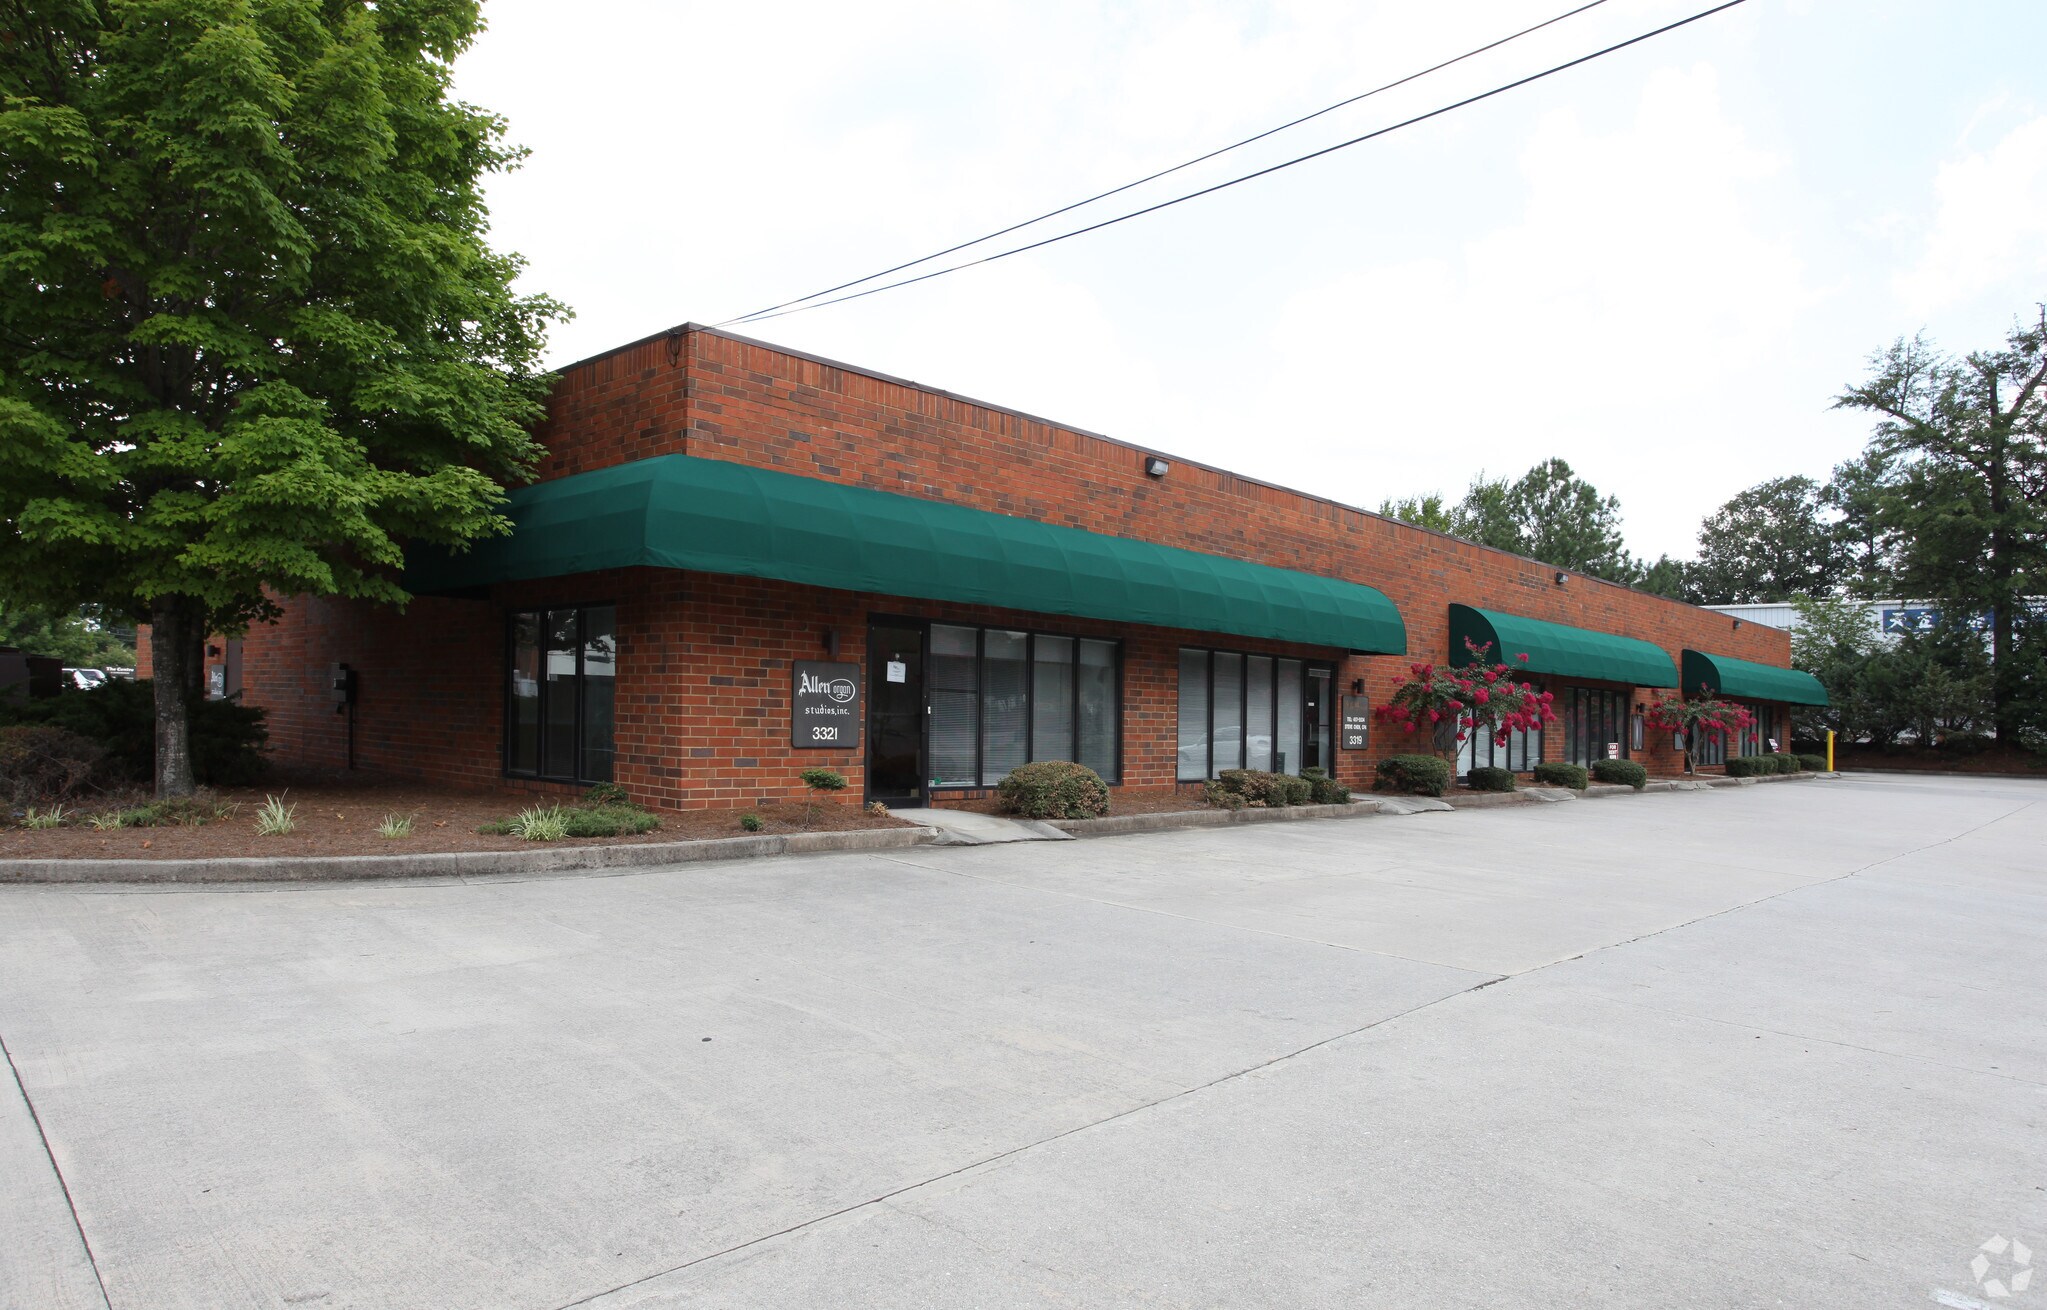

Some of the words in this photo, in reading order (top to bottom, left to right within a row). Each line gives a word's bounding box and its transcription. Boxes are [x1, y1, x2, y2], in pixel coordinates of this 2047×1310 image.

[799, 670, 830, 697] Allen
[832, 684, 851, 699] organ
[812, 727, 838, 740] 3321
[1349, 735, 1363, 745] 3319
